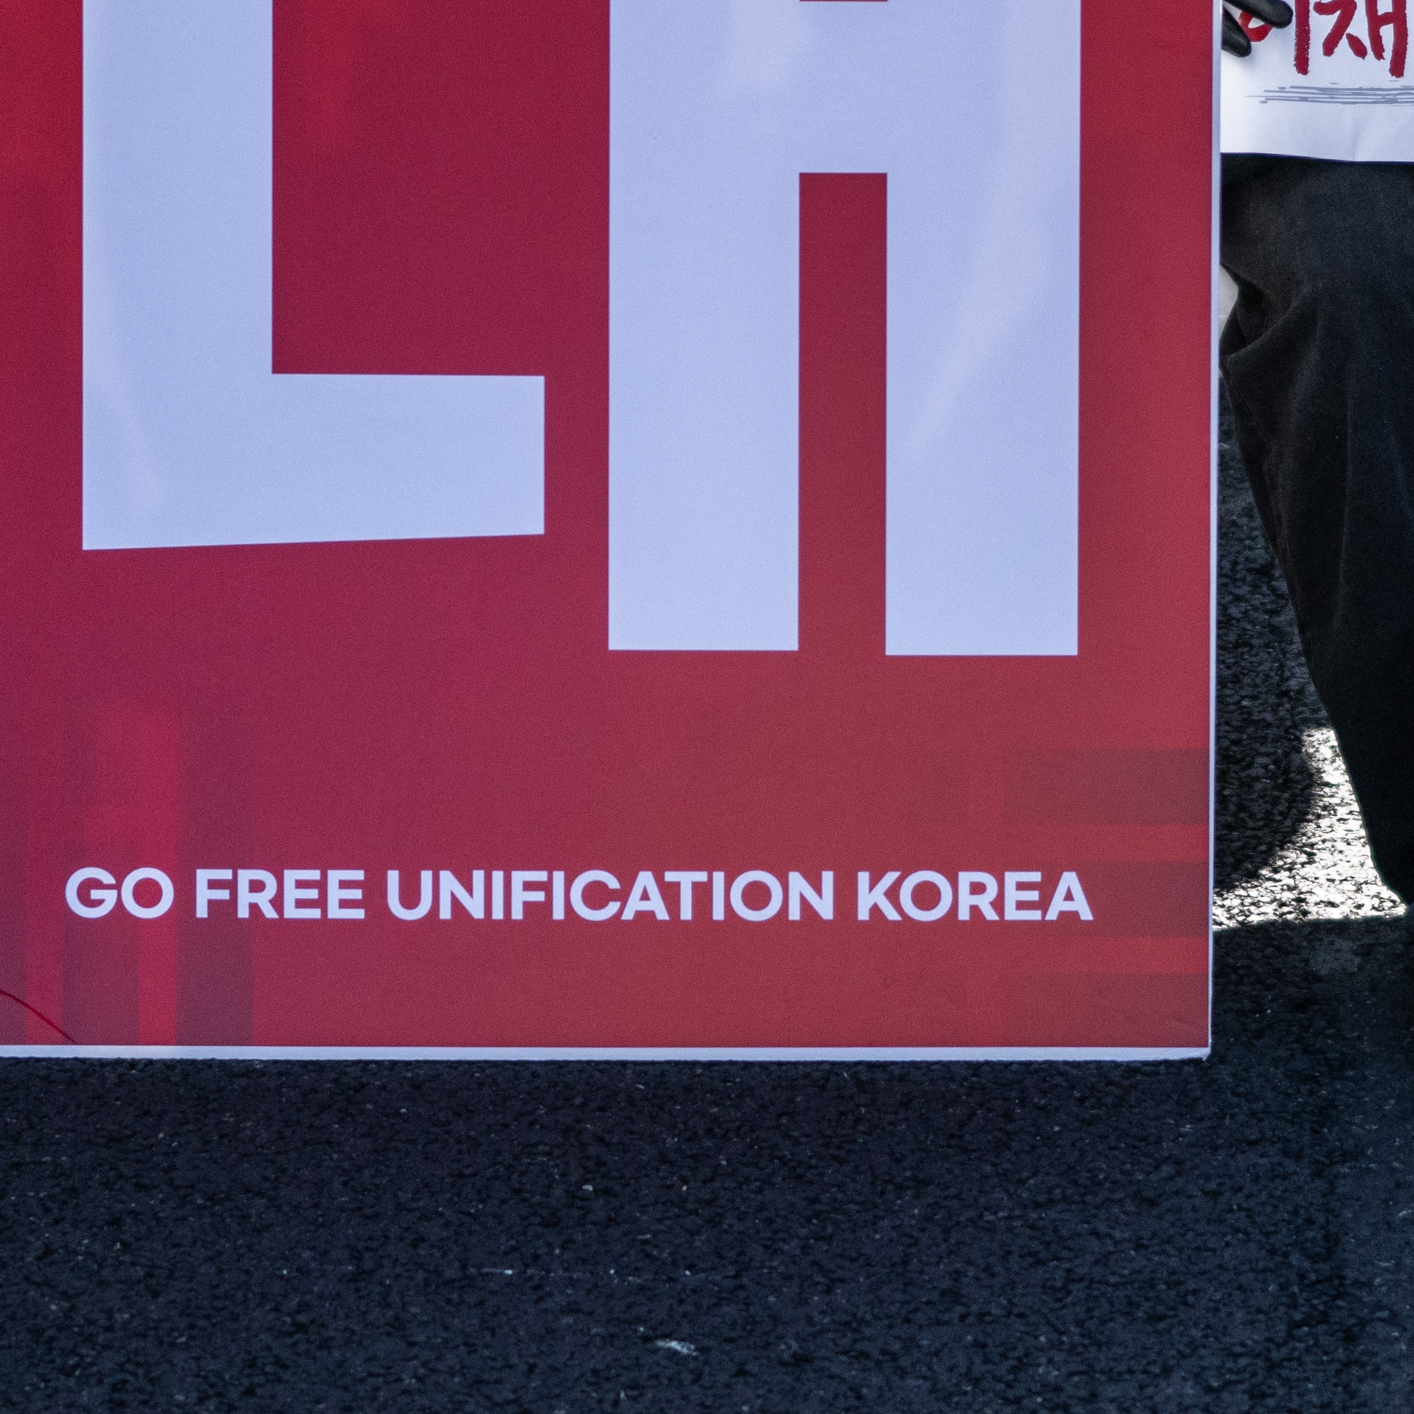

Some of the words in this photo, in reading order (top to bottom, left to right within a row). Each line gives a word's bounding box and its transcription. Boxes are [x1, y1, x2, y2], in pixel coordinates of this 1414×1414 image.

[65, 866, 175, 920] GO
[195, 869, 366, 919] FREE
[387, 868, 835, 922] UNIFICATION
[856, 870, 1093, 922] KOREA
